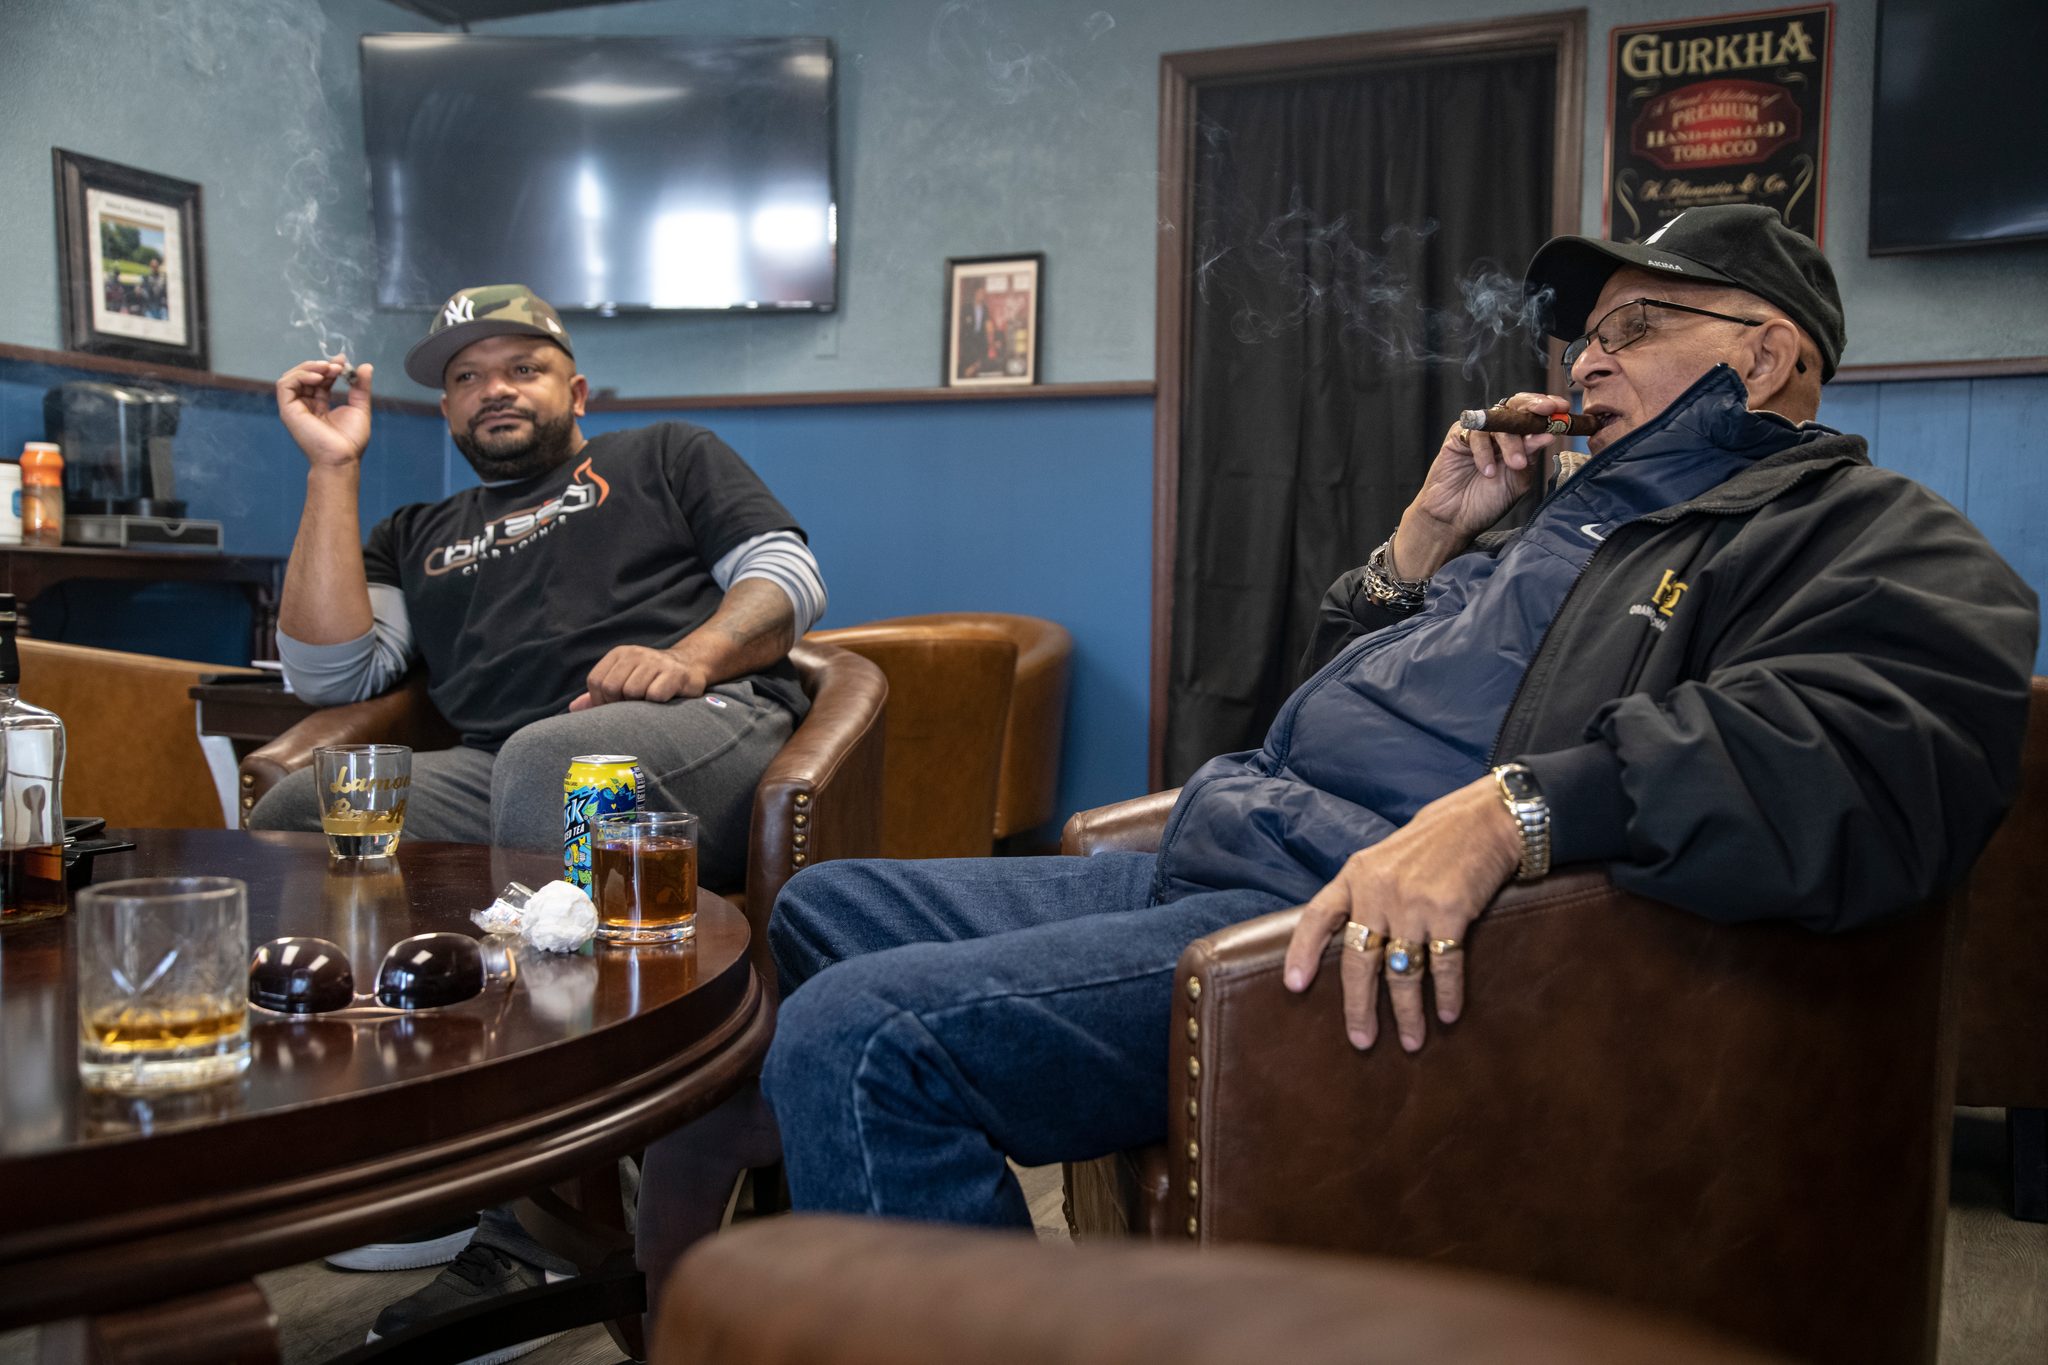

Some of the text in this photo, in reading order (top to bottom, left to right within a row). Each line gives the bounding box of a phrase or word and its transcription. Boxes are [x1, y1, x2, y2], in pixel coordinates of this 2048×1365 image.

[1621, 21, 1817, 80] GURKHA
[1671, 101, 1759, 129] PREMIUM
[1671, 139, 1758, 163] TOBACCO
[462, 548, 501, 576] CIAR
[573, 823, 585, 836] TEA
